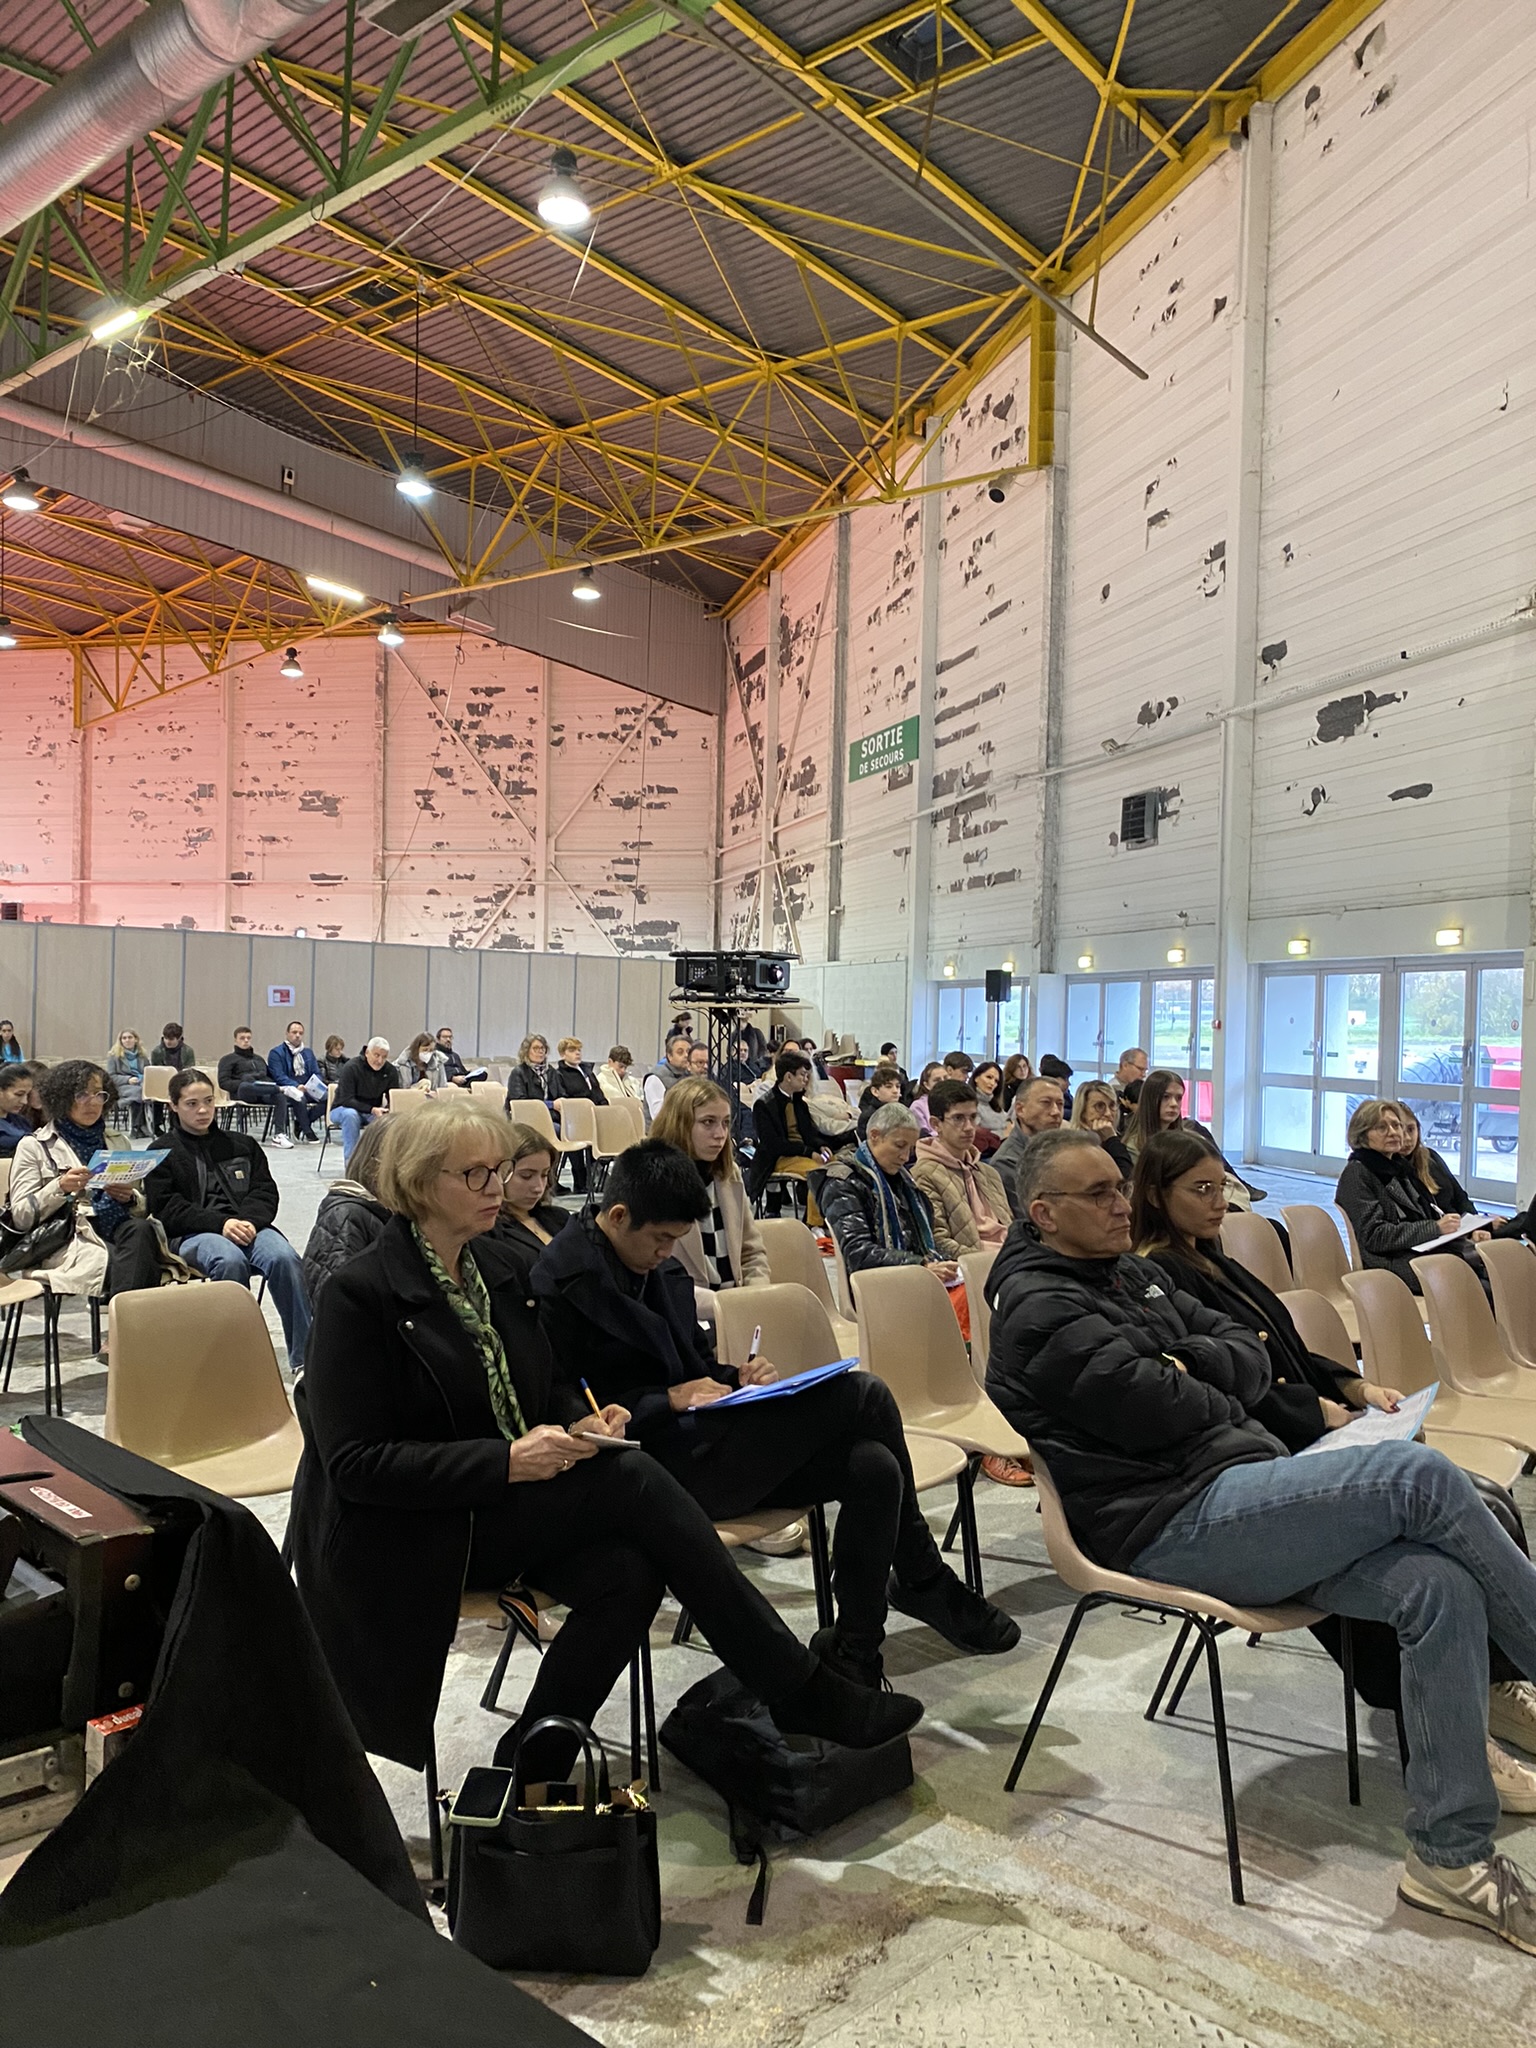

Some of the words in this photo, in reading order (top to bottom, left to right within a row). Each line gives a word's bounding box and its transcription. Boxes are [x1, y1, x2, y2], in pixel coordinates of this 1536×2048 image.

[861, 725, 903, 758] SORTIE
[859, 761, 868, 775] DE
[870, 748, 904, 771] SECOURS
